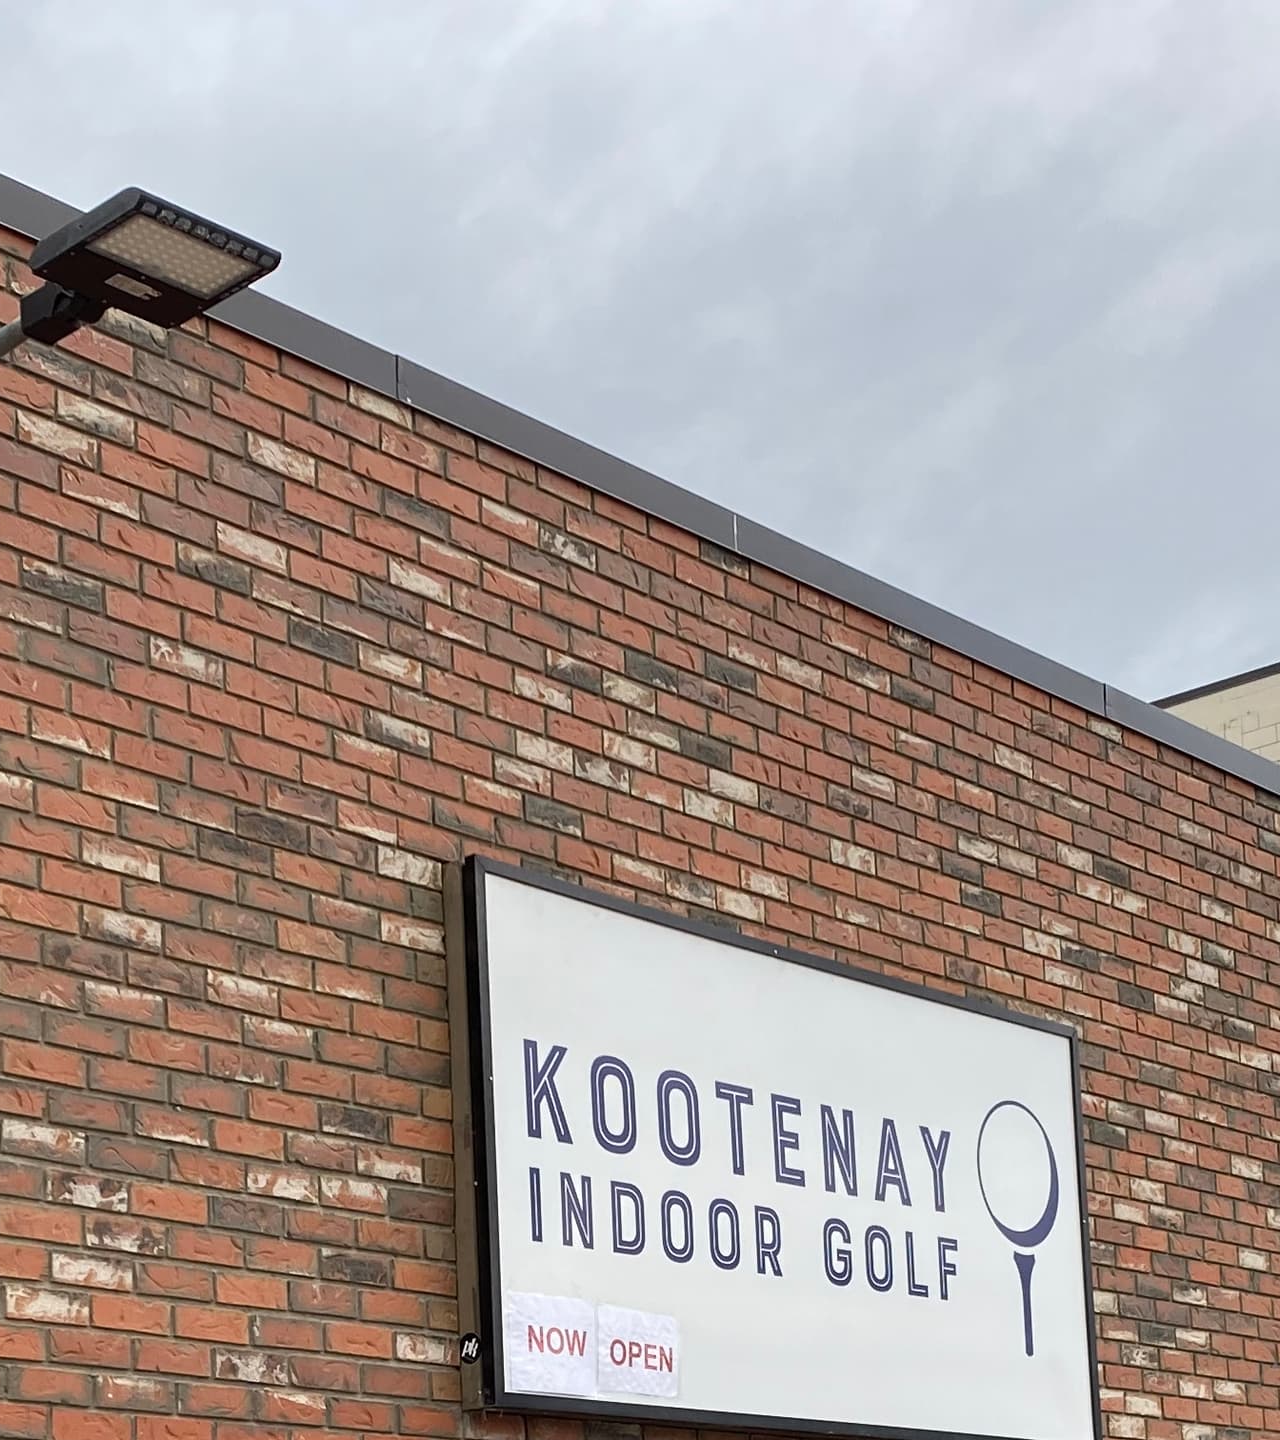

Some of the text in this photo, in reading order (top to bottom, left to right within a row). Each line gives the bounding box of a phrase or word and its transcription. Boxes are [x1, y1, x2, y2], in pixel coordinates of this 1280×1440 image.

[522, 1037, 951, 1213] KOOTENAY
[528, 1166, 959, 1301] INDOOR GOLF
[527, 1324, 673, 1373] NOW OPEN
